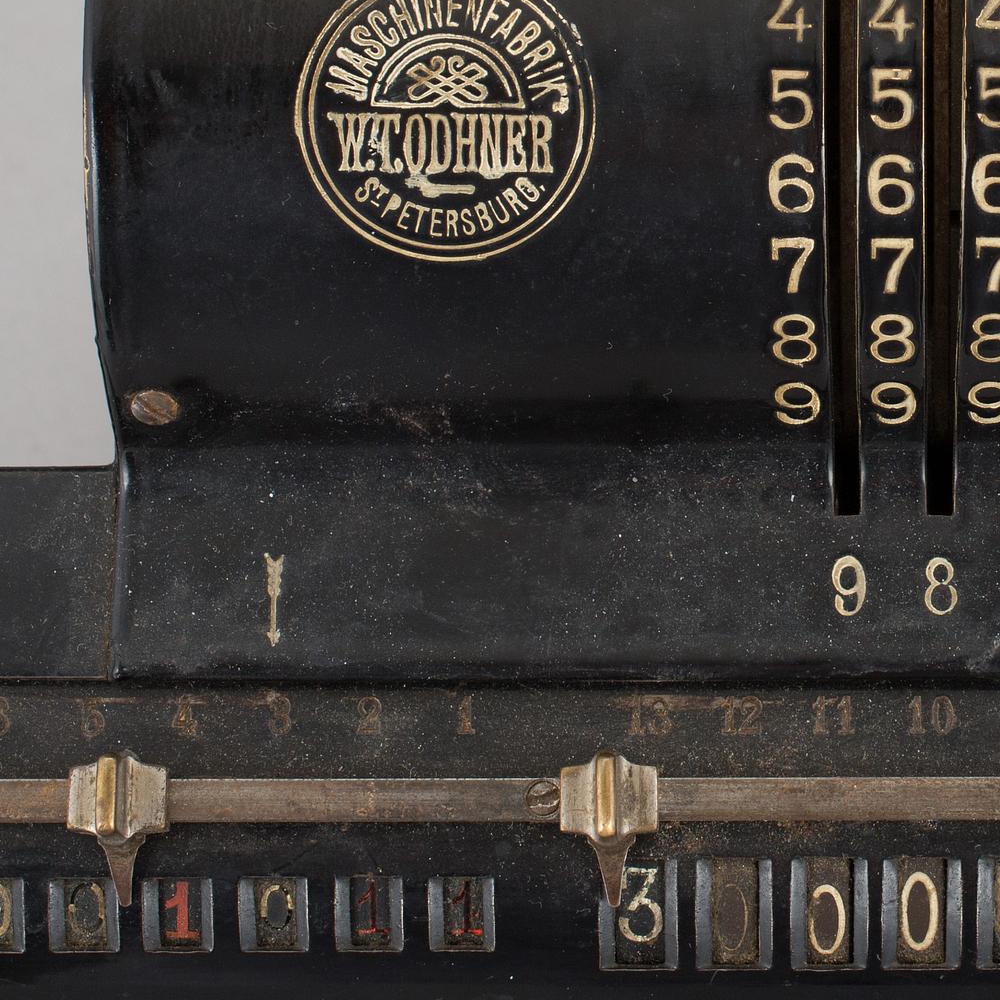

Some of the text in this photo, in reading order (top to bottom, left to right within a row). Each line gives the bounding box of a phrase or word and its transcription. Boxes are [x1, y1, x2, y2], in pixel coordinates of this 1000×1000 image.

[769, 69, 813, 129] 5
[870, 68, 912, 129] 5
[768, 154, 814, 214] 6
[867, 154, 915, 215] 6
[771, 237, 814, 294] 7
[871, 238, 913, 294] 7
[772, 313, 817, 365] 8
[870, 314, 914, 363] 8
[774, 382, 820, 424] 9
[870, 382, 916, 424] 9
[832, 555, 866, 616] 9
[924, 557, 958, 615] 8
[357, 697, 382, 735] 2
[907, 695, 957, 735] 10
[164, 881, 199, 939] 1
[259, 885, 295, 931] 0
[356, 872, 390, 935] 1
[449, 881, 483, 935] 1
[618, 868, 663, 943] 3
[809, 884, 846, 955] 0
[901, 871, 939, 951] 0
